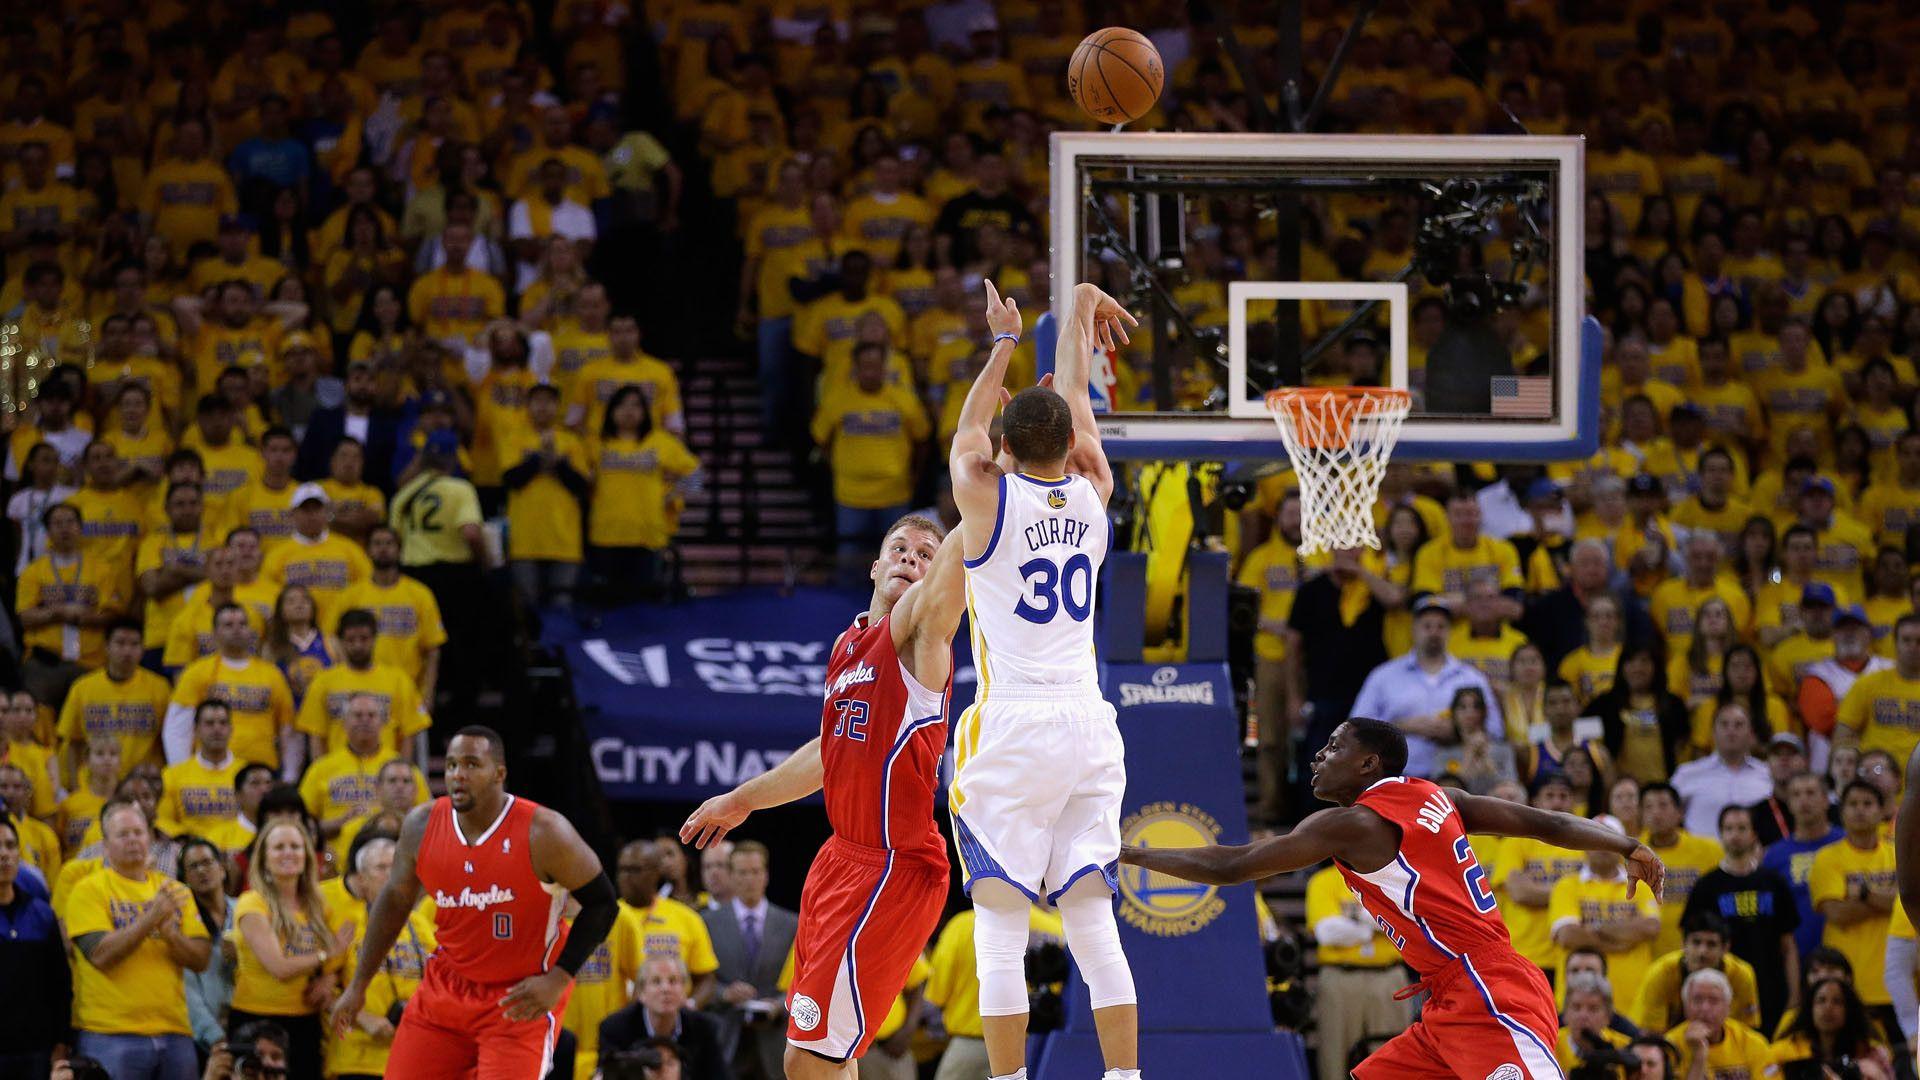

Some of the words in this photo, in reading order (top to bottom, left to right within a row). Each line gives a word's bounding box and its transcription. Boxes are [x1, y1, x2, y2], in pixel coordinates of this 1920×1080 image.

[1024, 517, 1089, 552] CURRY
[1013, 553, 1092, 625] 30
[685, 638, 826, 662] CITY
[1119, 681, 1215, 707] SPALDING
[833, 698, 870, 741] 32
[591, 737, 690, 784] CITY
[1416, 790, 1455, 834] COLL
[1452, 834, 1498, 914] 2
[459, 883, 514, 911] Angeles
[1118, 896, 1227, 938] WARRIORS
[492, 912, 513, 940] 0
